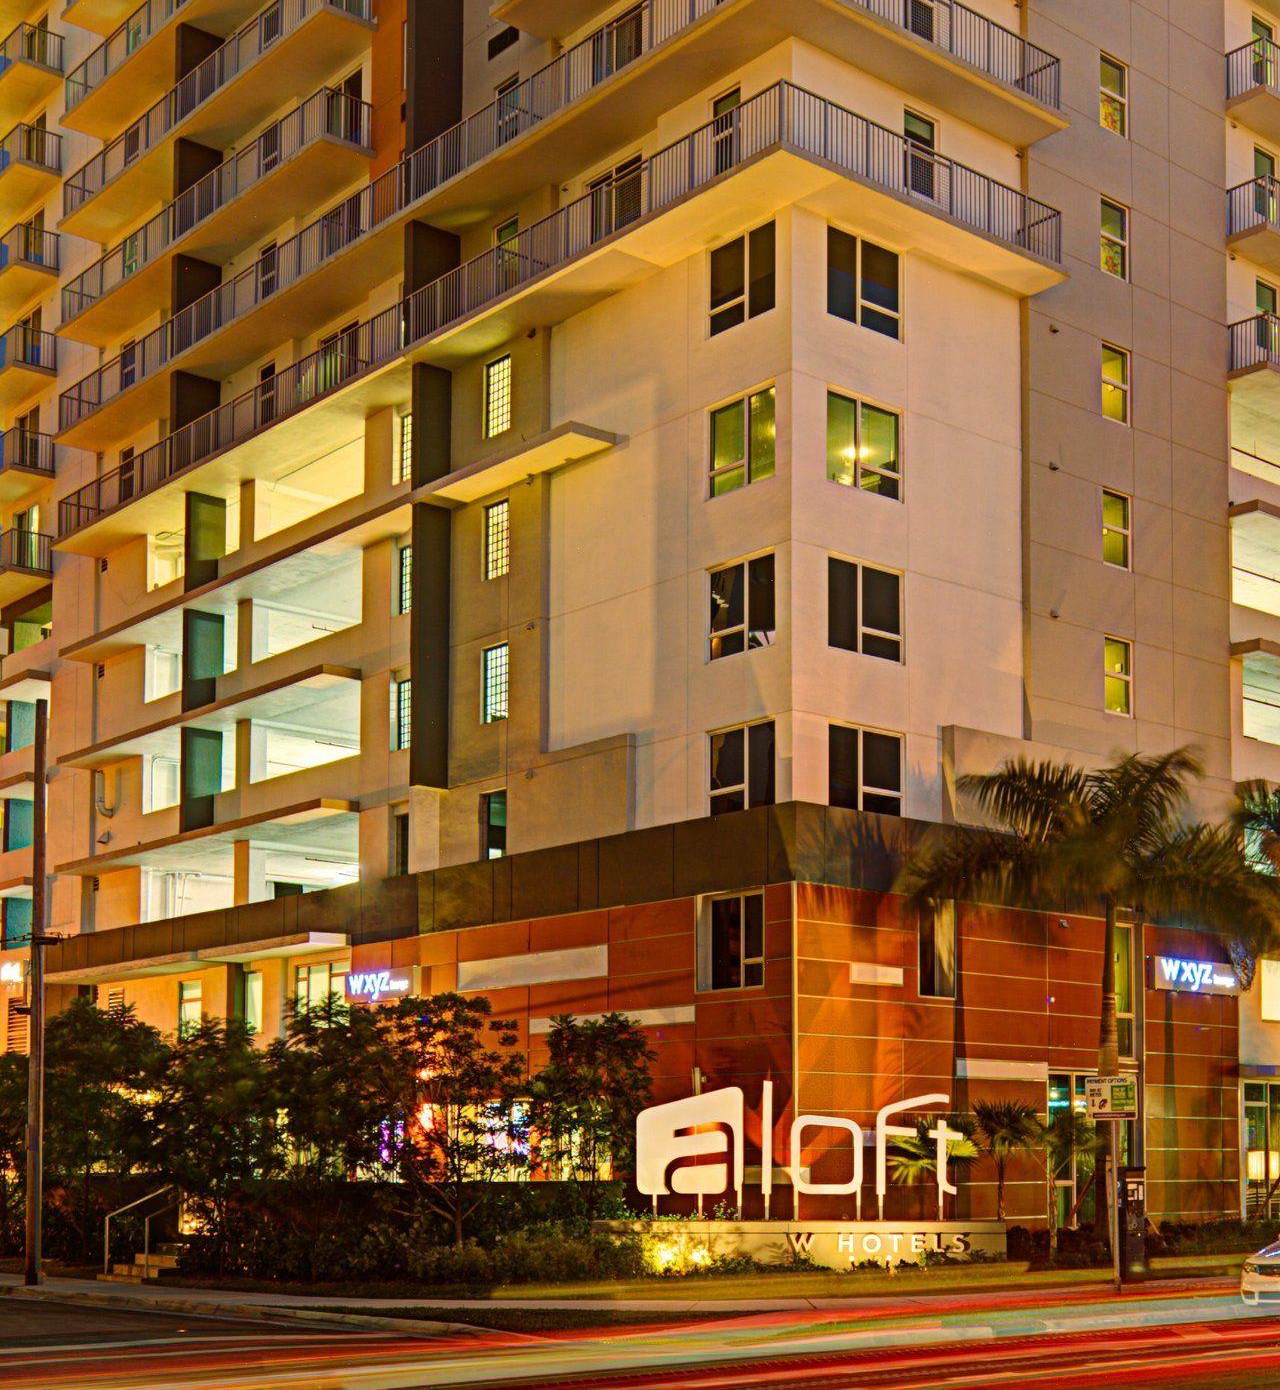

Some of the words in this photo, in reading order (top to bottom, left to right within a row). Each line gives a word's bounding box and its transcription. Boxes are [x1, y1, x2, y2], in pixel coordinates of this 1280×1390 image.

[636, 1080, 963, 1196] aloft
[789, 1234, 815, 1253] W
[838, 1233, 965, 1253] HOTELS
